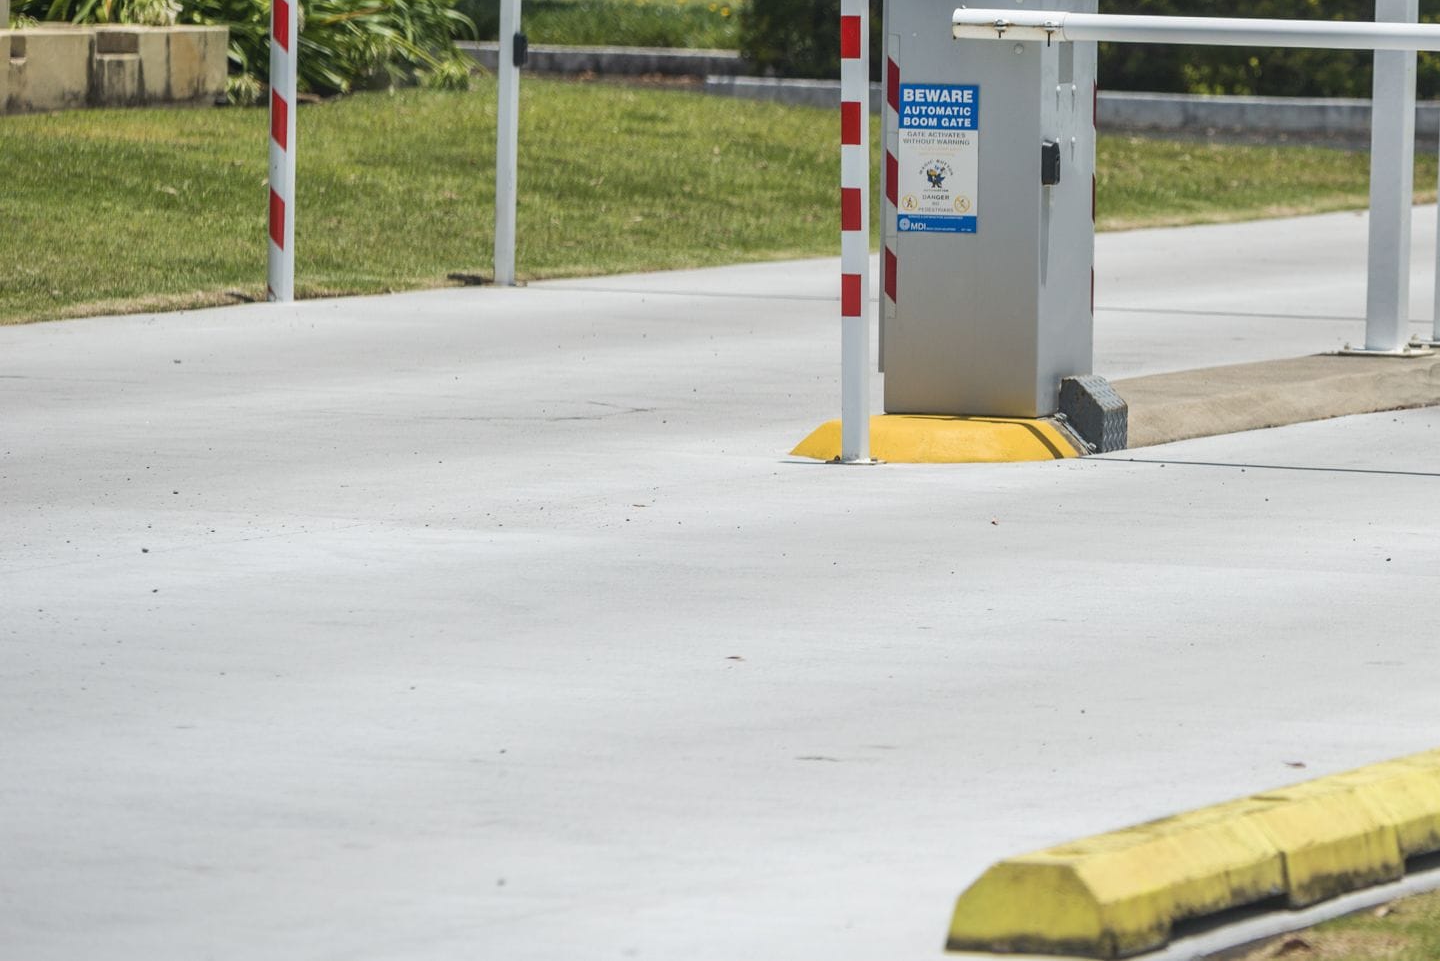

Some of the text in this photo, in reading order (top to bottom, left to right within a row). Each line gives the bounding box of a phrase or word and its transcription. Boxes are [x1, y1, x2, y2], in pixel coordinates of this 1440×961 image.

[903, 88, 973, 103] BEWARE
[904, 106, 971, 116] AUTOMATIC
[903, 117, 971, 127] BOOM GATE
[910, 222, 927, 231] MDI
